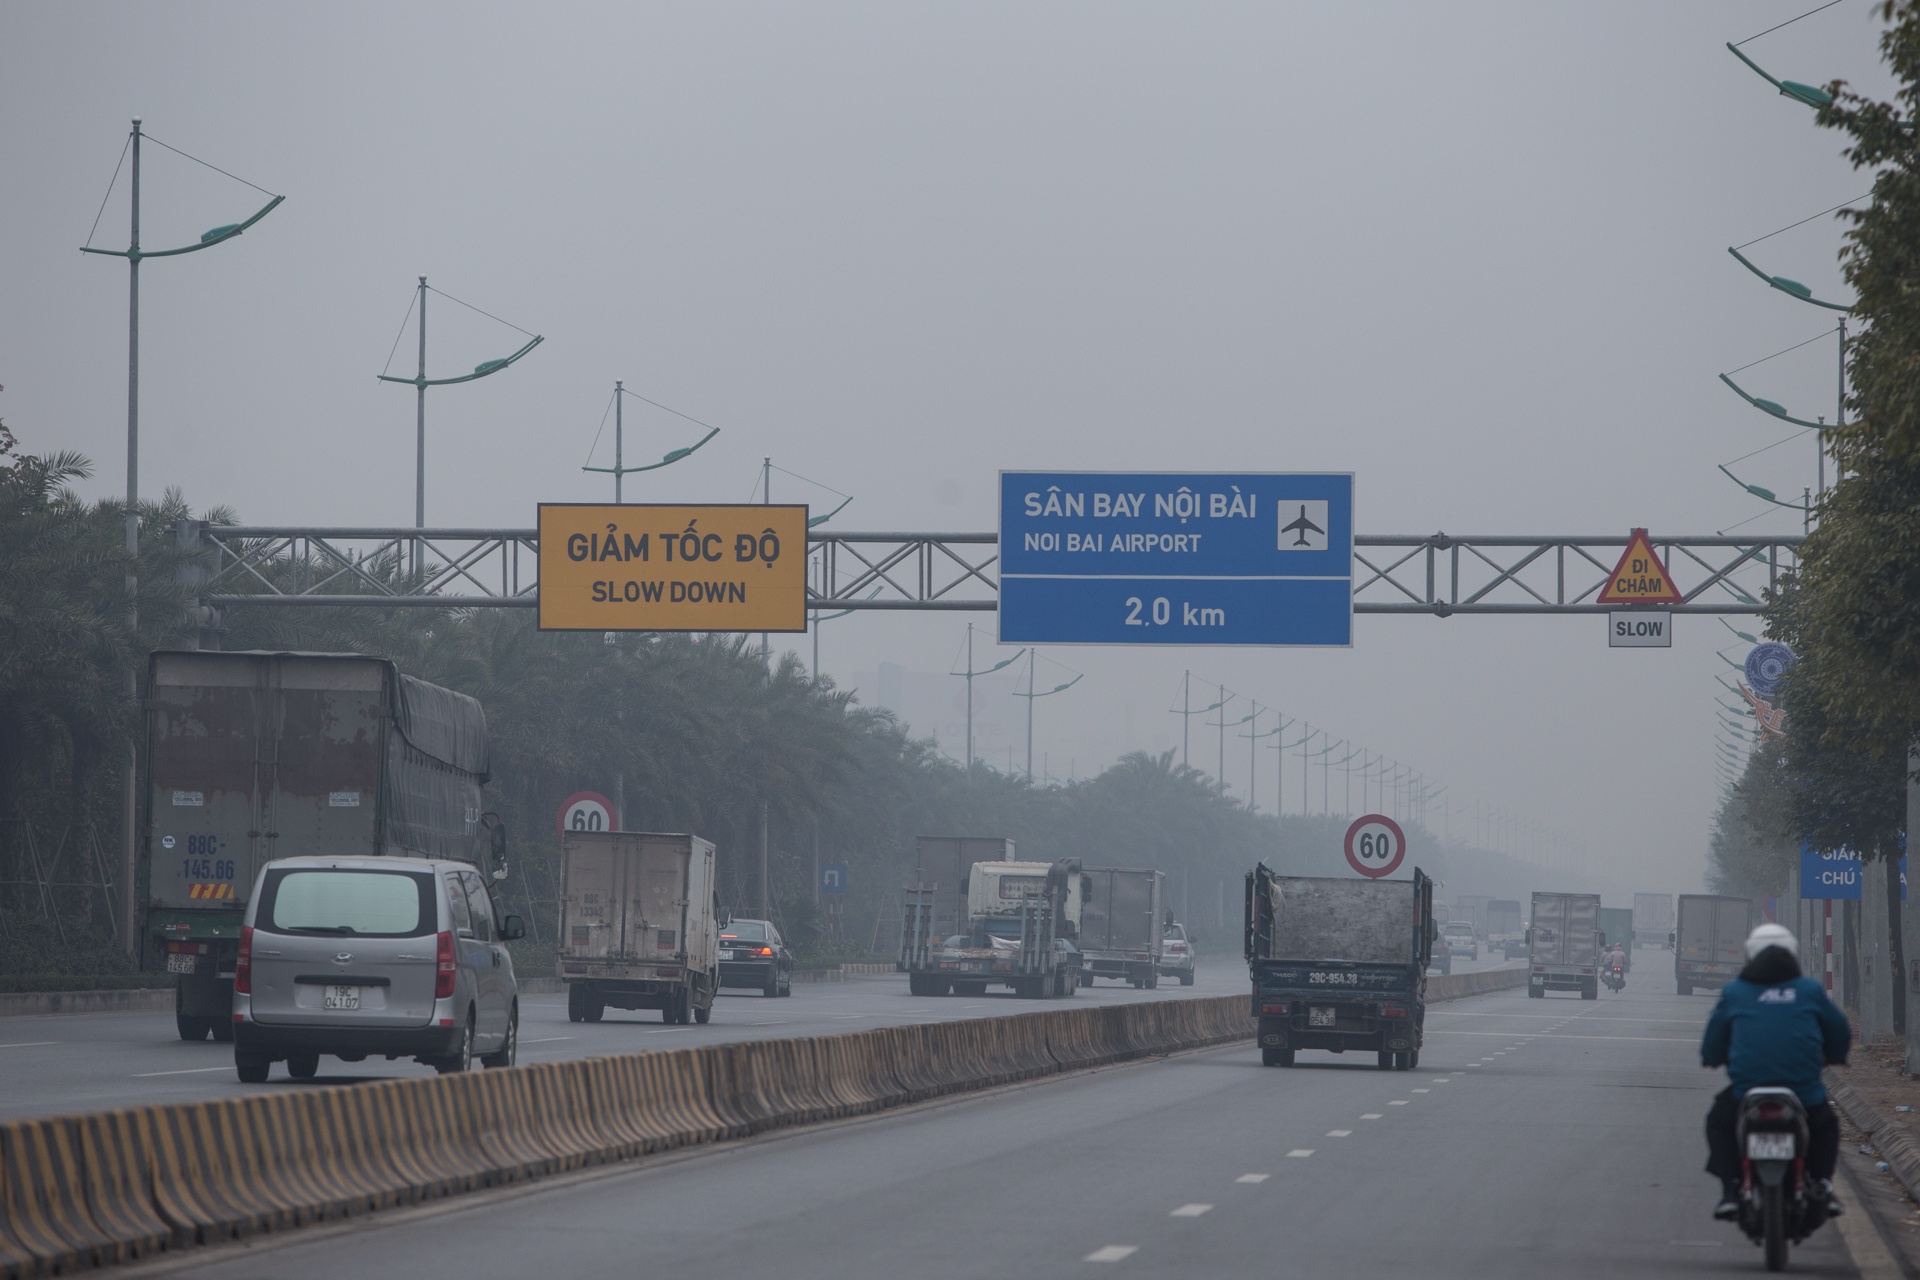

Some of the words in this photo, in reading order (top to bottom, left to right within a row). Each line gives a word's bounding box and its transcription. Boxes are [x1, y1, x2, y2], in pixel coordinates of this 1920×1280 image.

[1024, 486, 1084, 517] SÂN
[1093, 493, 1145, 518] BAY
[1155, 486, 1200, 524] NỘI
[1210, 485, 1256, 518] BÀI
[567, 522, 649, 562] GIẢM
[659, 518, 723, 562] TỐC
[734, 527, 780, 569] ĐỘ
[1024, 533, 1059, 551] NOI
[1067, 533, 1102, 552] BAI
[1110, 534, 1202, 553] AIRPORT
[1631, 558, 1649, 574] ĐI
[591, 580, 664, 603] SLOW
[670, 581, 746, 603] DOWN
[1616, 575, 1662, 596] CHẬM
[1183, 602, 1225, 626] km
[1616, 621, 1663, 637] SLOW
[572, 809, 602, 831] 60
[1359, 832, 1390, 859] 60
[183, 859, 234, 880] 145.66
[174, 954, 189, 964] 88C
[1309, 972, 1358, 984] 29C-954.38
[334, 986, 352, 997] 19C
